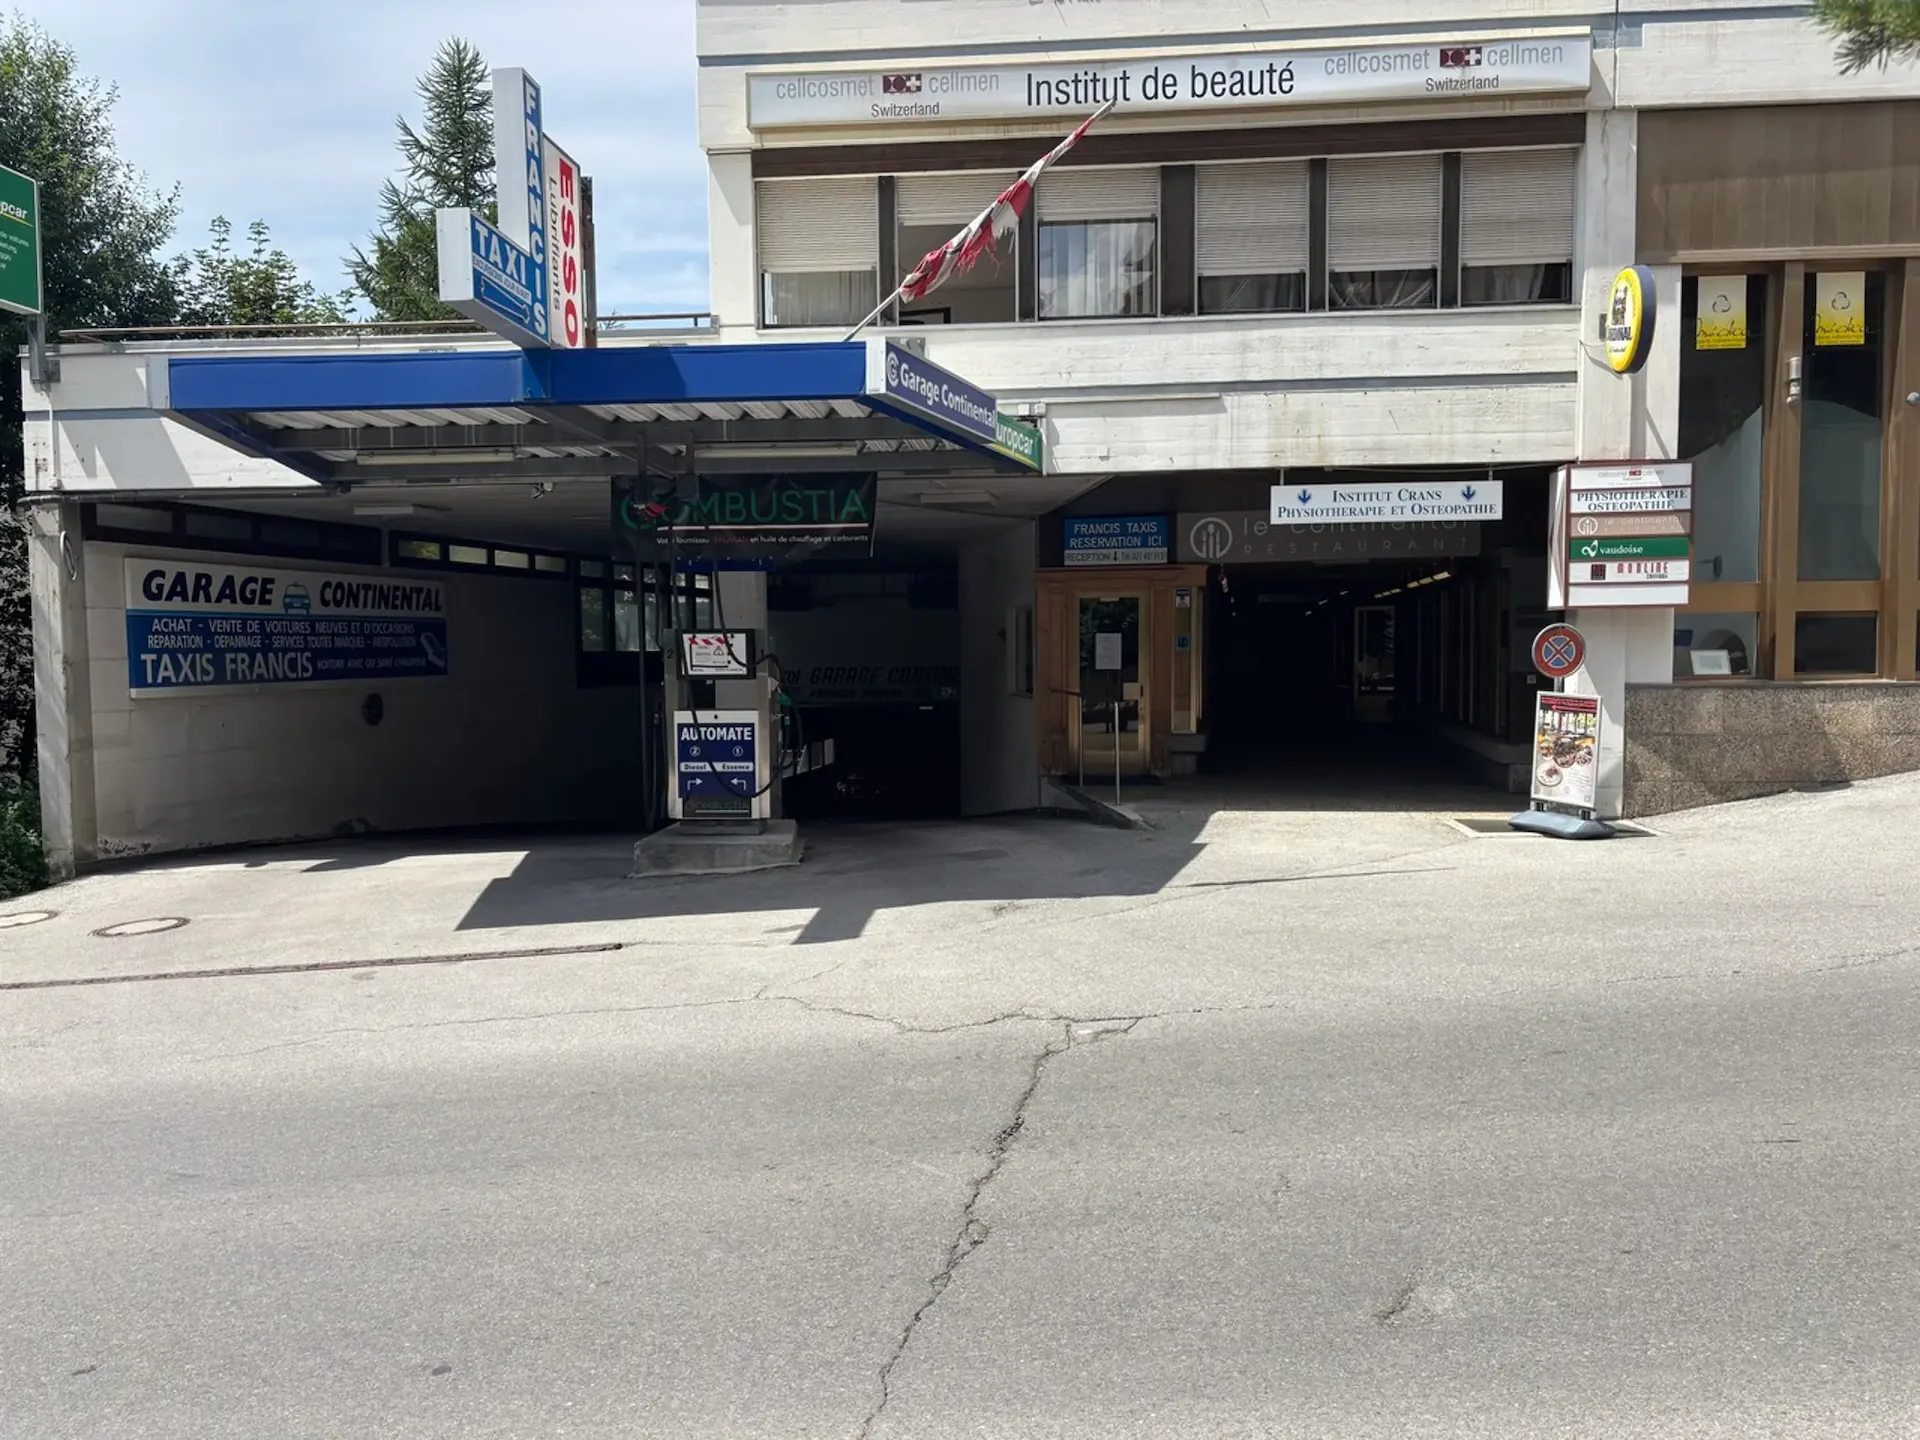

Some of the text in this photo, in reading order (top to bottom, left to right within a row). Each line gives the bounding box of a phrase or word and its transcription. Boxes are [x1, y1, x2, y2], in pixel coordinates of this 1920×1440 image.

[1324, 44, 1563, 76] cellcosmet cellmen
[776, 71, 999, 99] cellcosmet cellmen
[1026, 60, 1294, 106] Institut de beauté
[1425, 75, 1499, 93] Switzerland
[871, 101, 940, 118] Switzerland
[525, 82, 547, 336] FRANCIS
[475, 220, 526, 287] TAXI
[559, 157, 578, 348] ESSO
[900, 363, 940, 405] Garage
[941, 384, 996, 429] Continental
[1332, 488, 1443, 502] INSTITUT CRANS
[1577, 489, 1688, 502] PHYSIOTHERAPIE
[1278, 503, 1497, 518] PHYSIOTHERAPIE ET OSTEOPATHIE
[1588, 500, 1675, 511] OSTEOPATHIE
[1073, 521, 1158, 535] FRANCIS TAXIS
[1069, 535, 1162, 549] RESERVATION ICI
[1600, 544, 1643, 554] vaudoise
[143, 570, 442, 612] GARAGE CONTINENTAL
[152, 618, 193, 633] ACHAT
[208, 618, 242, 633] VENTE
[247, 619, 260, 633] DE
[264, 620, 312, 635] VOITURES
[315, 621, 349, 634] NEUVES
[140, 651, 314, 684] TAXIS FRANCIS
[681, 727, 753, 741] AUTOMATE
